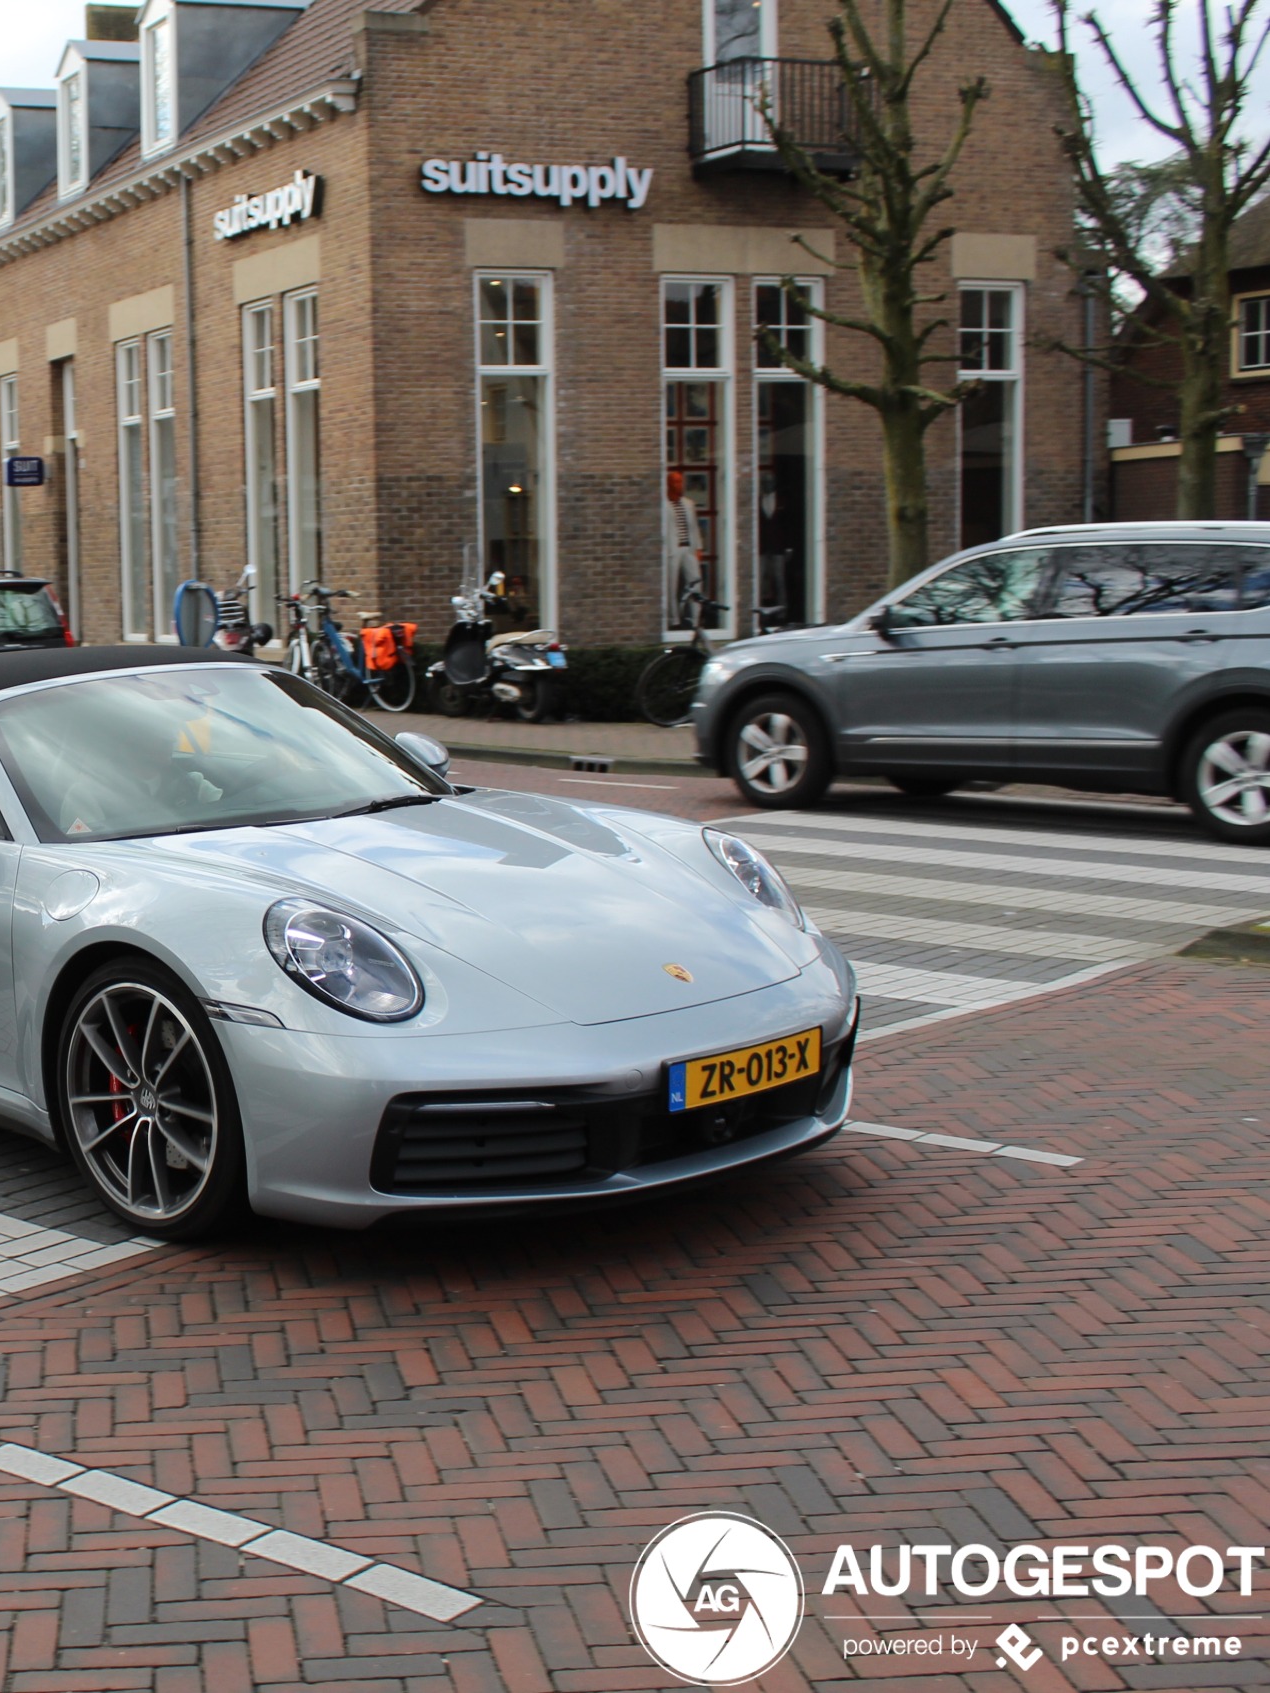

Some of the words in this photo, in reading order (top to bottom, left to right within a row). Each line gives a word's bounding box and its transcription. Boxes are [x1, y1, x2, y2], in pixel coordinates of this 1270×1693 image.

[213, 169, 317, 241] suitsupply
[421, 151, 654, 209] suitsupply
[671, 1091, 684, 1104] NL
[700, 1038, 810, 1099] ZR-013-X
